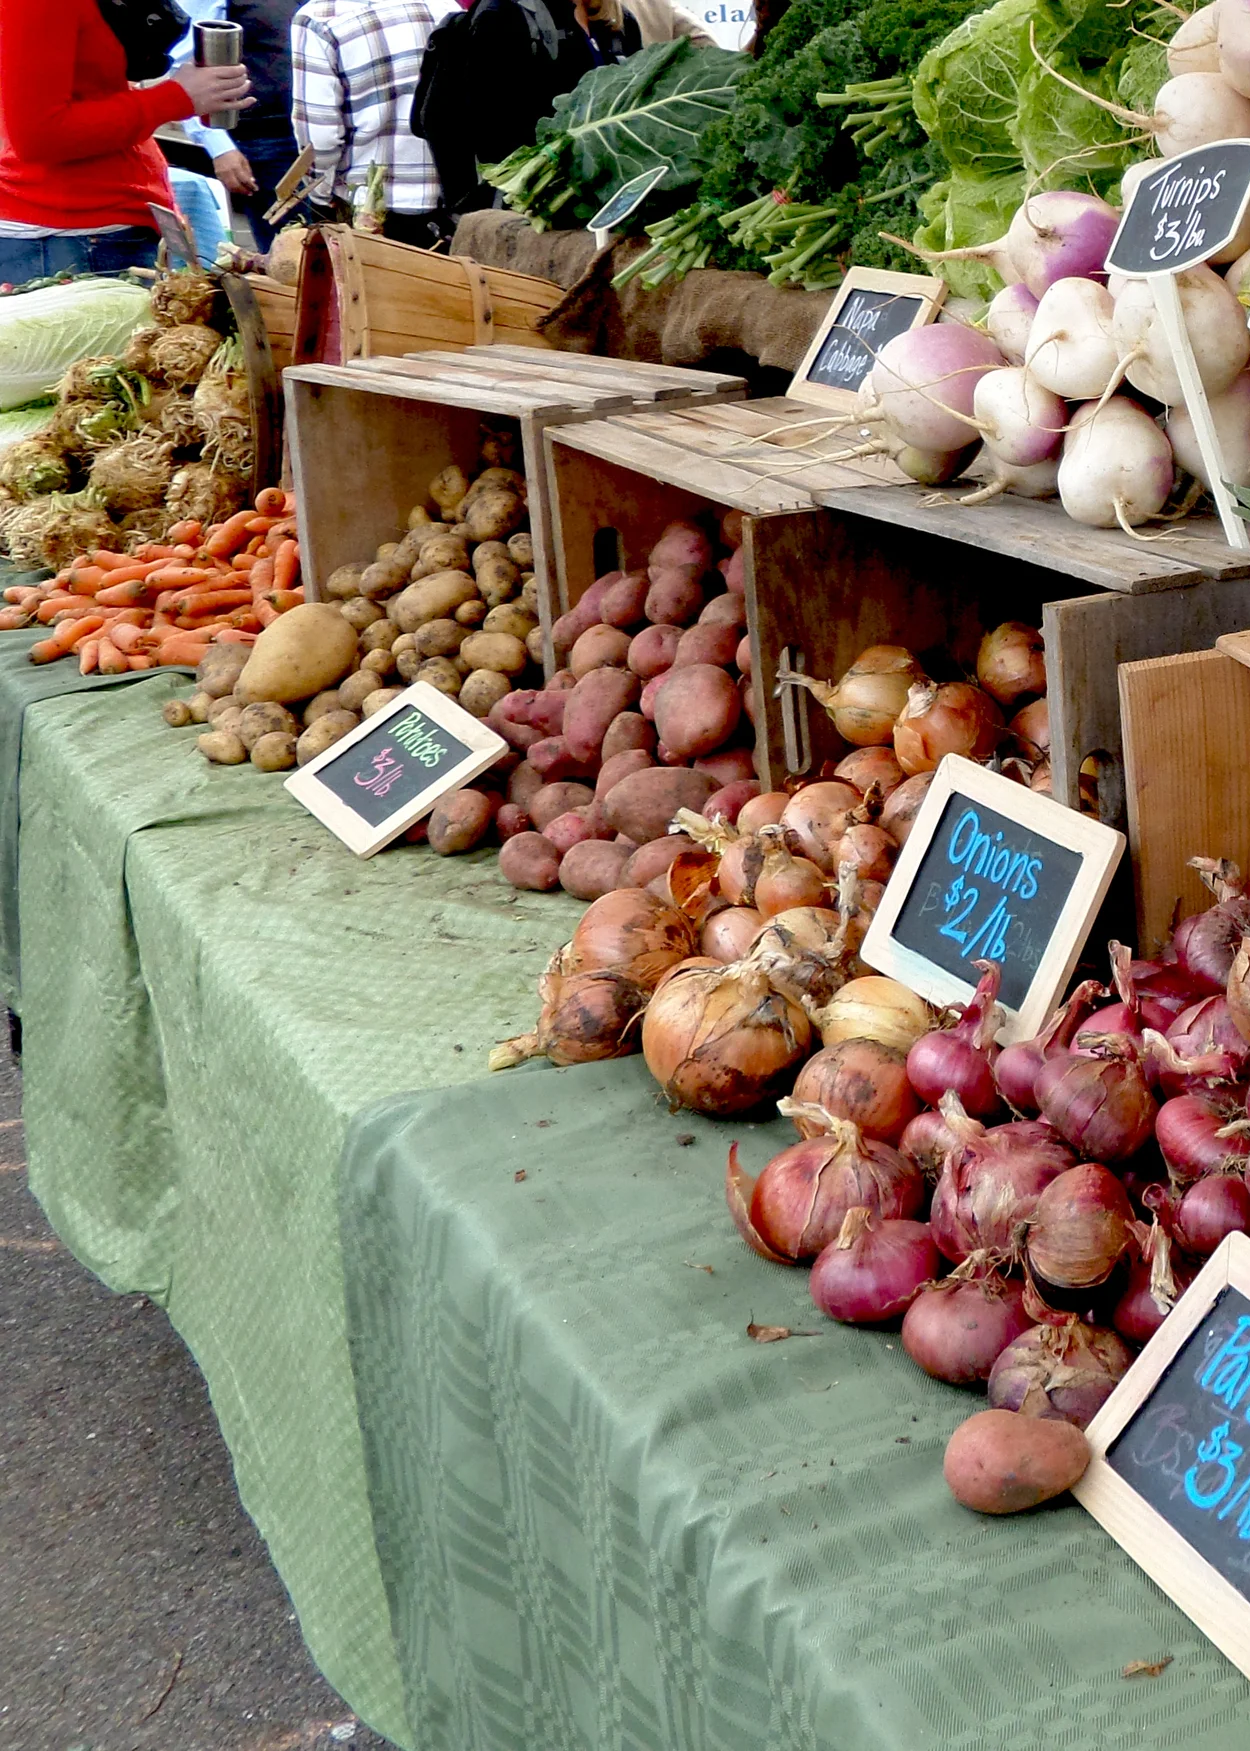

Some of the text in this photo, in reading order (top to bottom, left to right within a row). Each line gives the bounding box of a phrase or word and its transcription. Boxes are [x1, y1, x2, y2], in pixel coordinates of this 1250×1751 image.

[704, 4, 757, 24] ela
[1149, 163, 1227, 223] Turnips
[842, 297, 881, 336] Napa
[819, 339, 868, 381] Cabbage
[388, 712, 447, 768] Potatoes
[948, 809, 1043, 900] Onions
[939, 874, 1012, 963] $2/lb.
